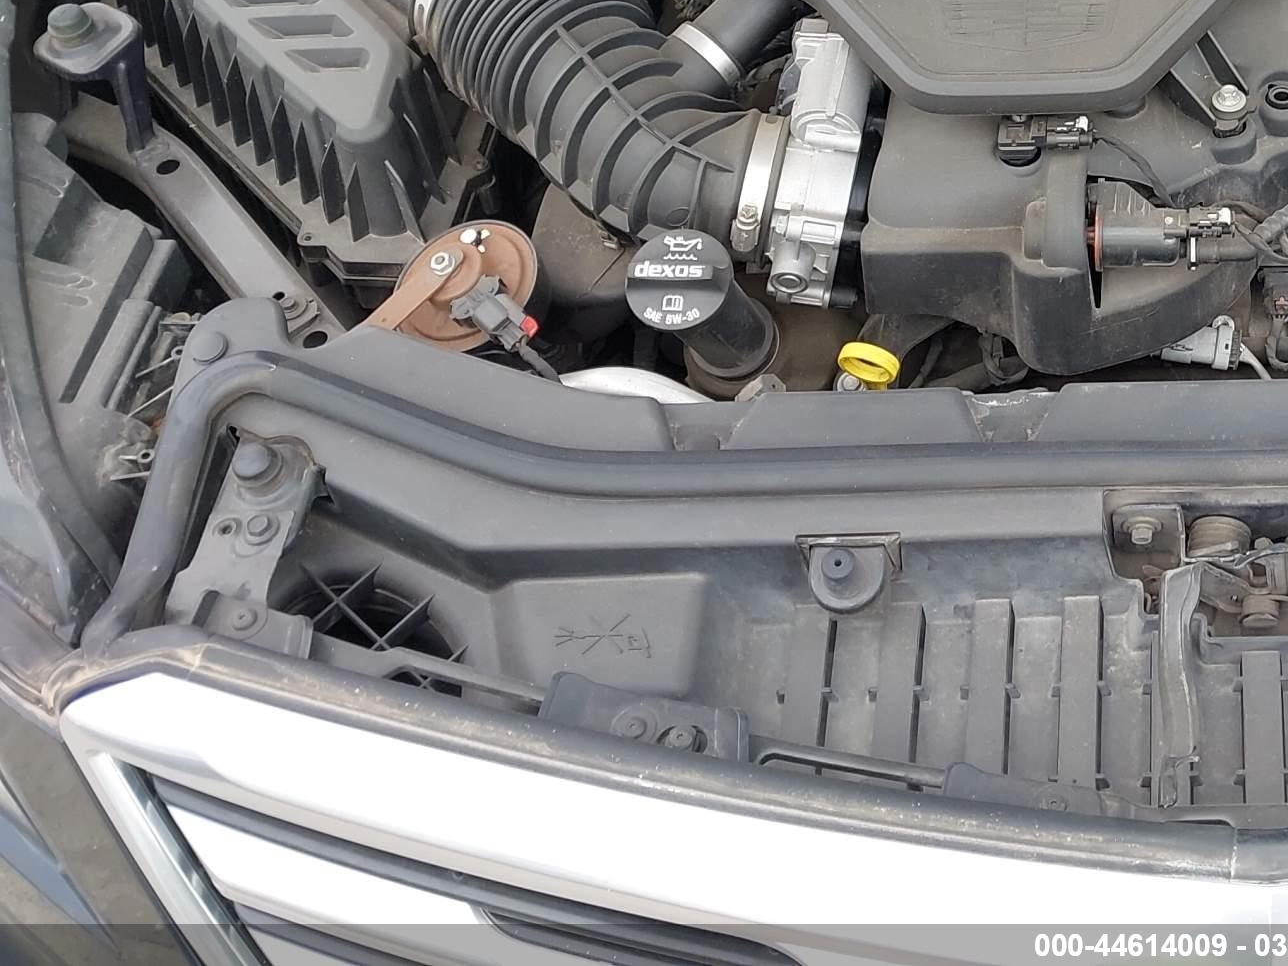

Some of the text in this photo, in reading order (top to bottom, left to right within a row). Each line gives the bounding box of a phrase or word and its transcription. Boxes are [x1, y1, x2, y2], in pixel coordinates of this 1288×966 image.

[634, 260, 704, 277] dexos
[643, 307, 700, 325] SAE 5W-30
